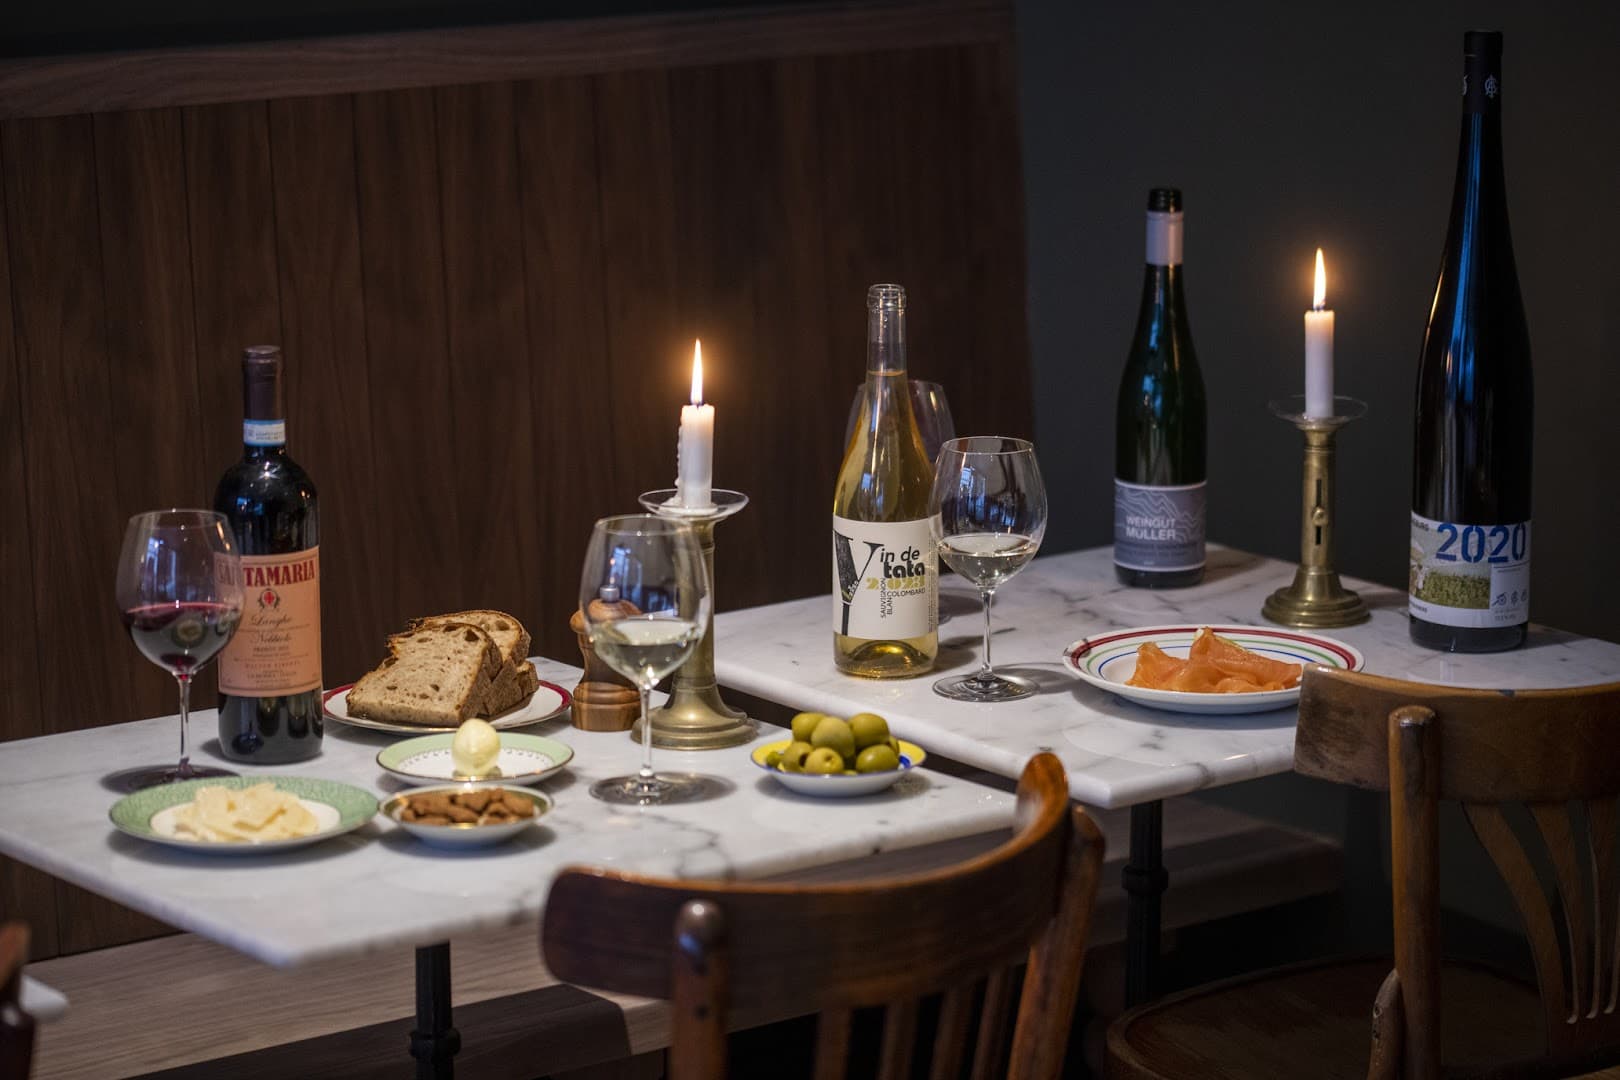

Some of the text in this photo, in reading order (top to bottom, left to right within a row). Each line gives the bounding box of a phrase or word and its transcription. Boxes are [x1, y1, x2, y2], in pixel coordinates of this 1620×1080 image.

[1126, 515, 1176, 528] WEINGUT
[1436, 522, 1526, 563] 2020
[901, 546, 920, 562] de
[883, 561, 925, 578] tata
[886, 588, 925, 598] COLOMBARD
